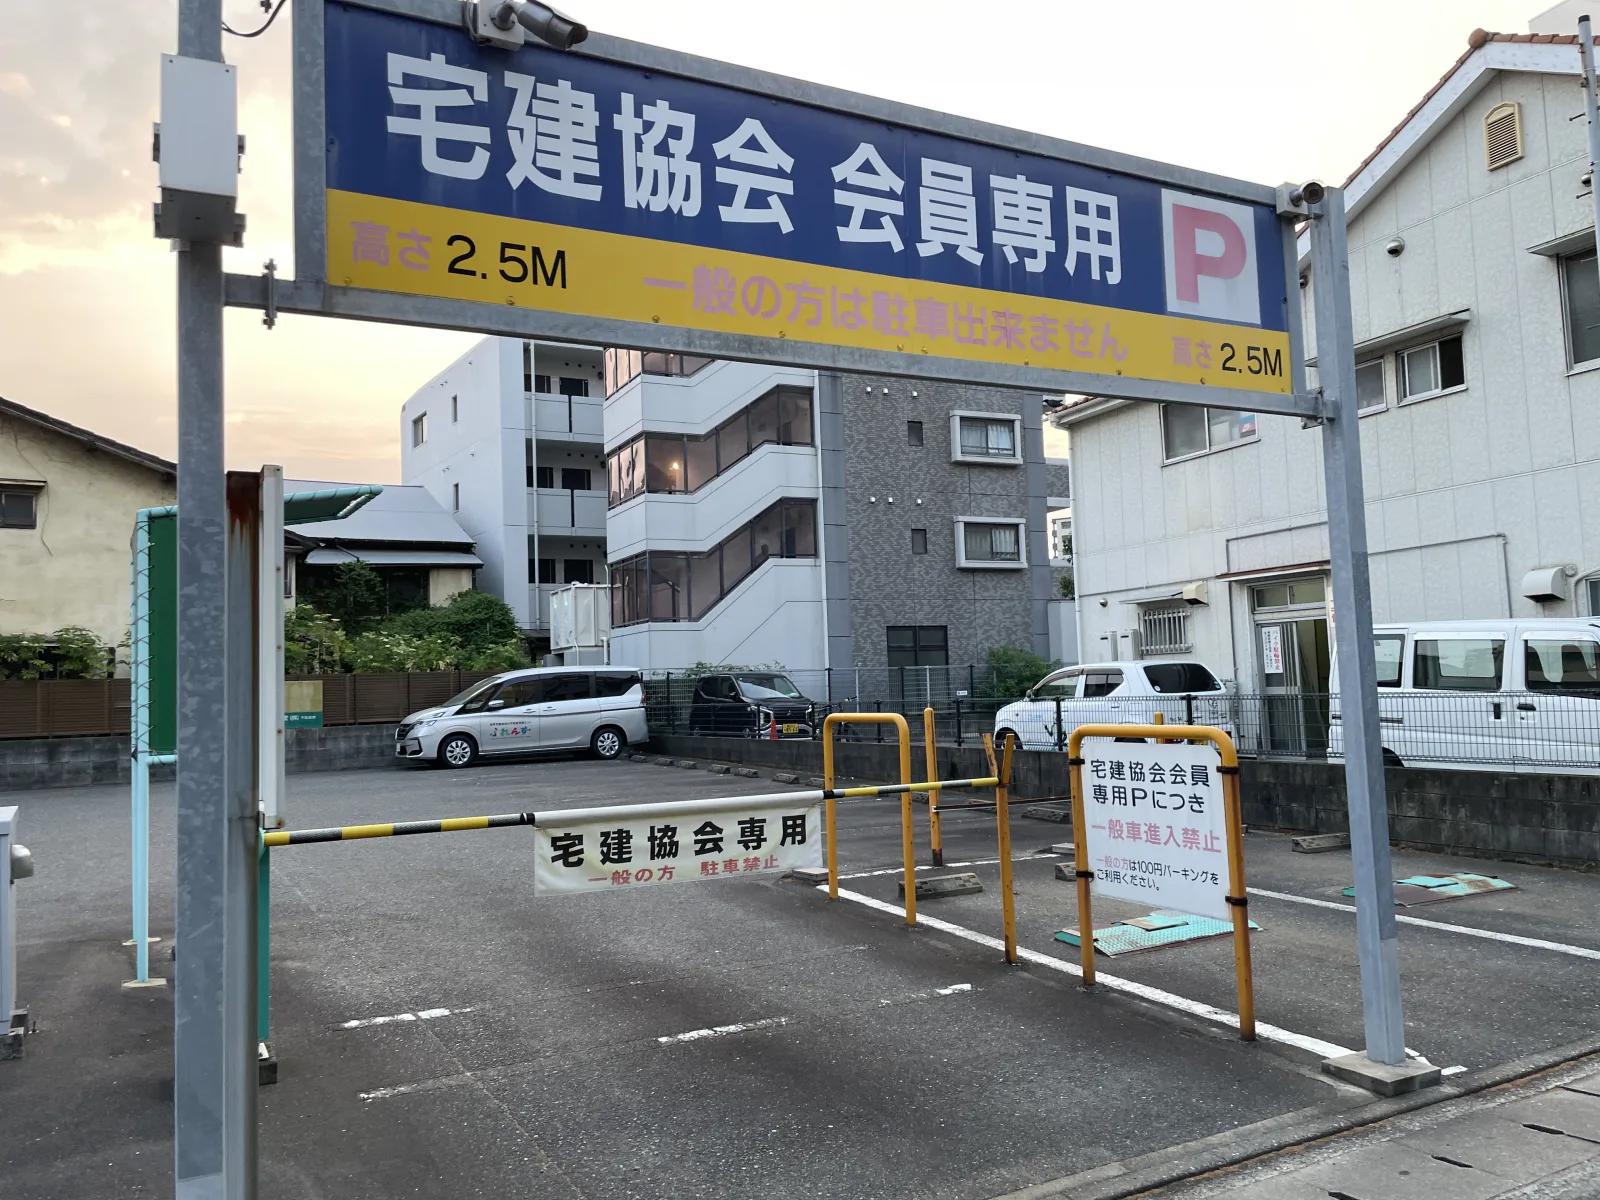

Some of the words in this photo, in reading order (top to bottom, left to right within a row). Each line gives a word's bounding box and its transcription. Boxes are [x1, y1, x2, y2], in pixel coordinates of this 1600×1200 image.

[386, 52, 796, 234] 宅建協会
[830, 143, 1123, 285] 会員専用
[350, 219, 432, 271] 高さ
[446, 233, 568, 289] 2.5M
[1172, 204, 1246, 302] P
[643, 263, 1128, 362] 一般の方は駐車出来ません
[1171, 335, 1213, 370] 高さ
[1220, 342, 1283, 378] 2.5M
[1091, 759, 1210, 787] 宅建協会会員
[1093, 784, 1205, 813] 専用Pにつき
[551, 814, 807, 868] 宅建協会専用
[1091, 818, 1222, 853] 一般車進入禁止
[588, 865, 676, 886] 一般の方
[700, 855, 780, 876] 駐車禁止
[1096, 855, 1219, 885] 一般の方は100円パーキングを
[1097, 869, 1160, 891] ご利用ください。
